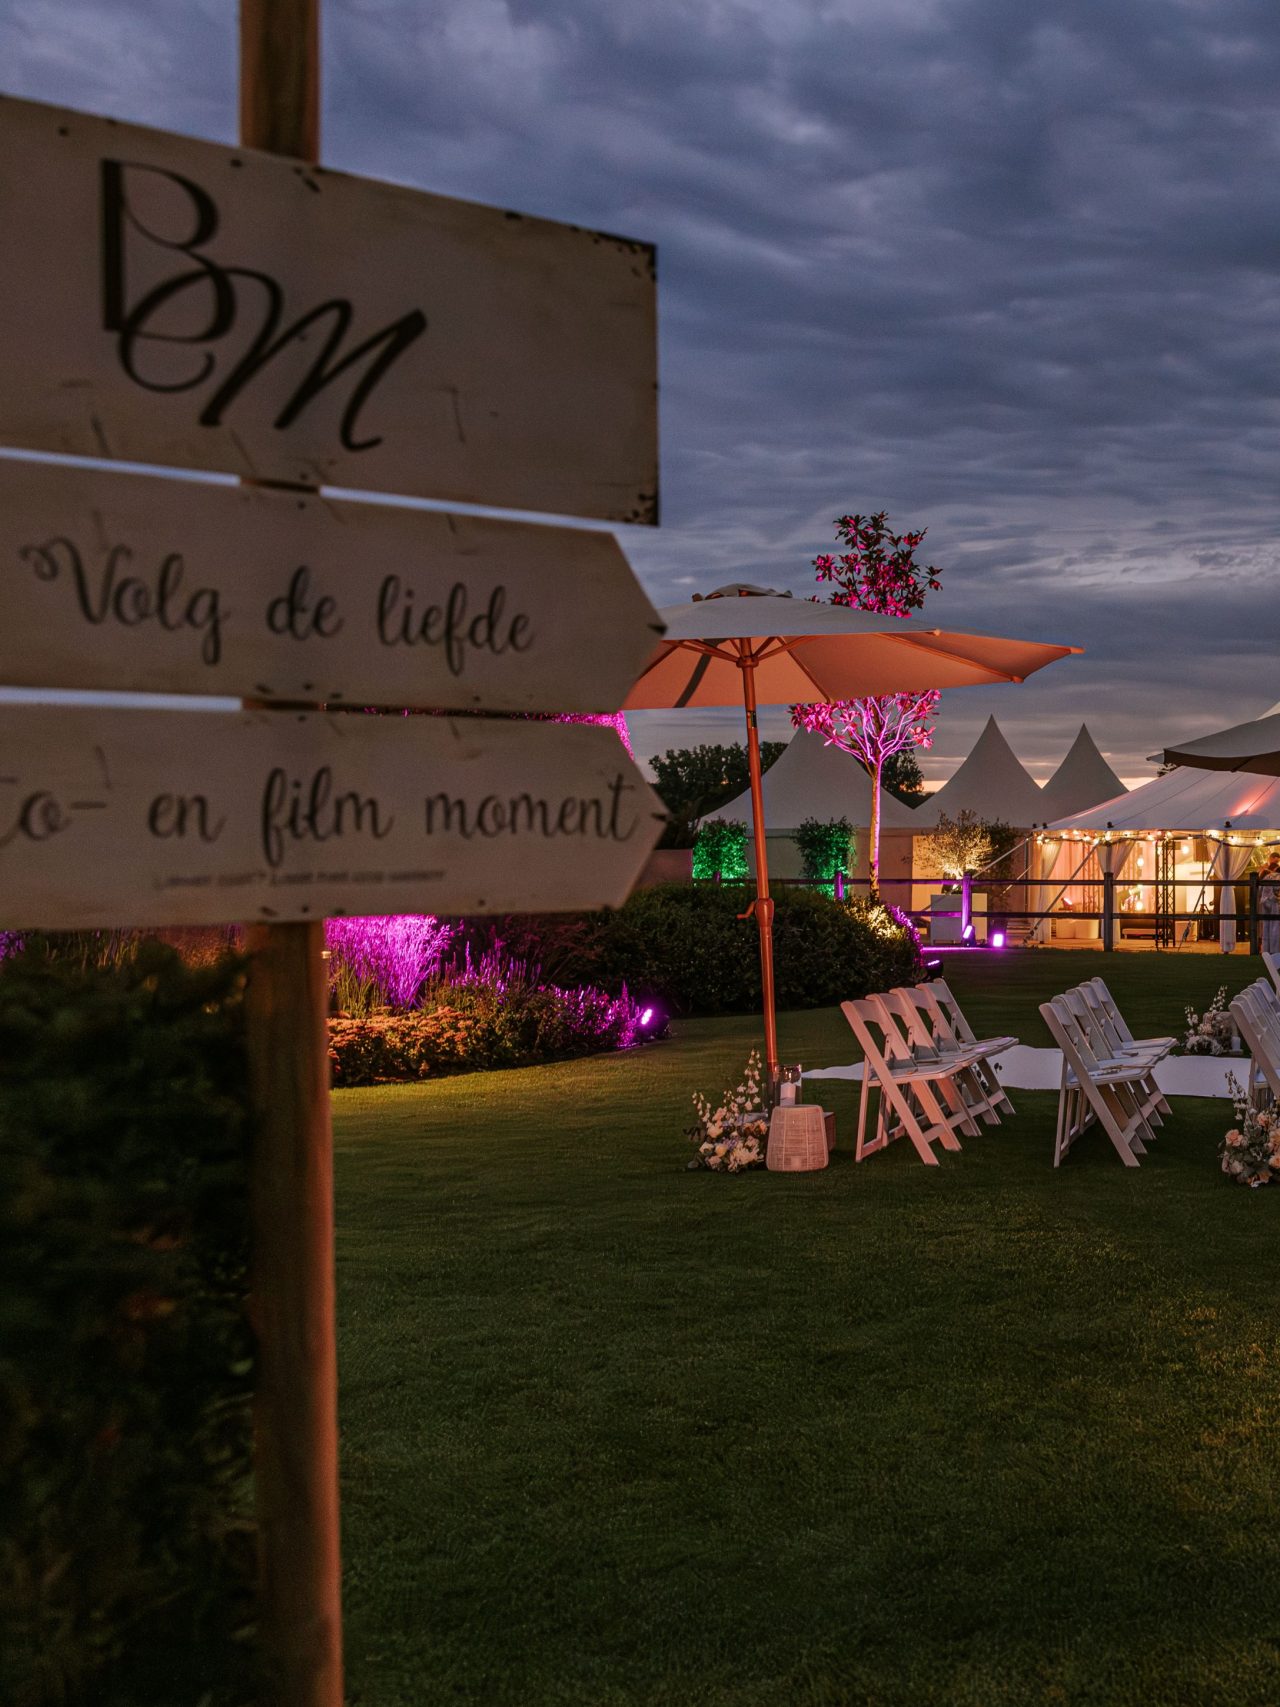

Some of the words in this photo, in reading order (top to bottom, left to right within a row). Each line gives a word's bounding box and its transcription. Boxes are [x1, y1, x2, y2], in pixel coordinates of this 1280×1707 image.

[20, 535, 224, 666] Volg
[265, 565, 344, 641] de
[376, 573, 534, 677] liefde
[147, 790, 224, 843] en
[260, 765, 394, 868] film
[423, 772, 640, 842] moment
